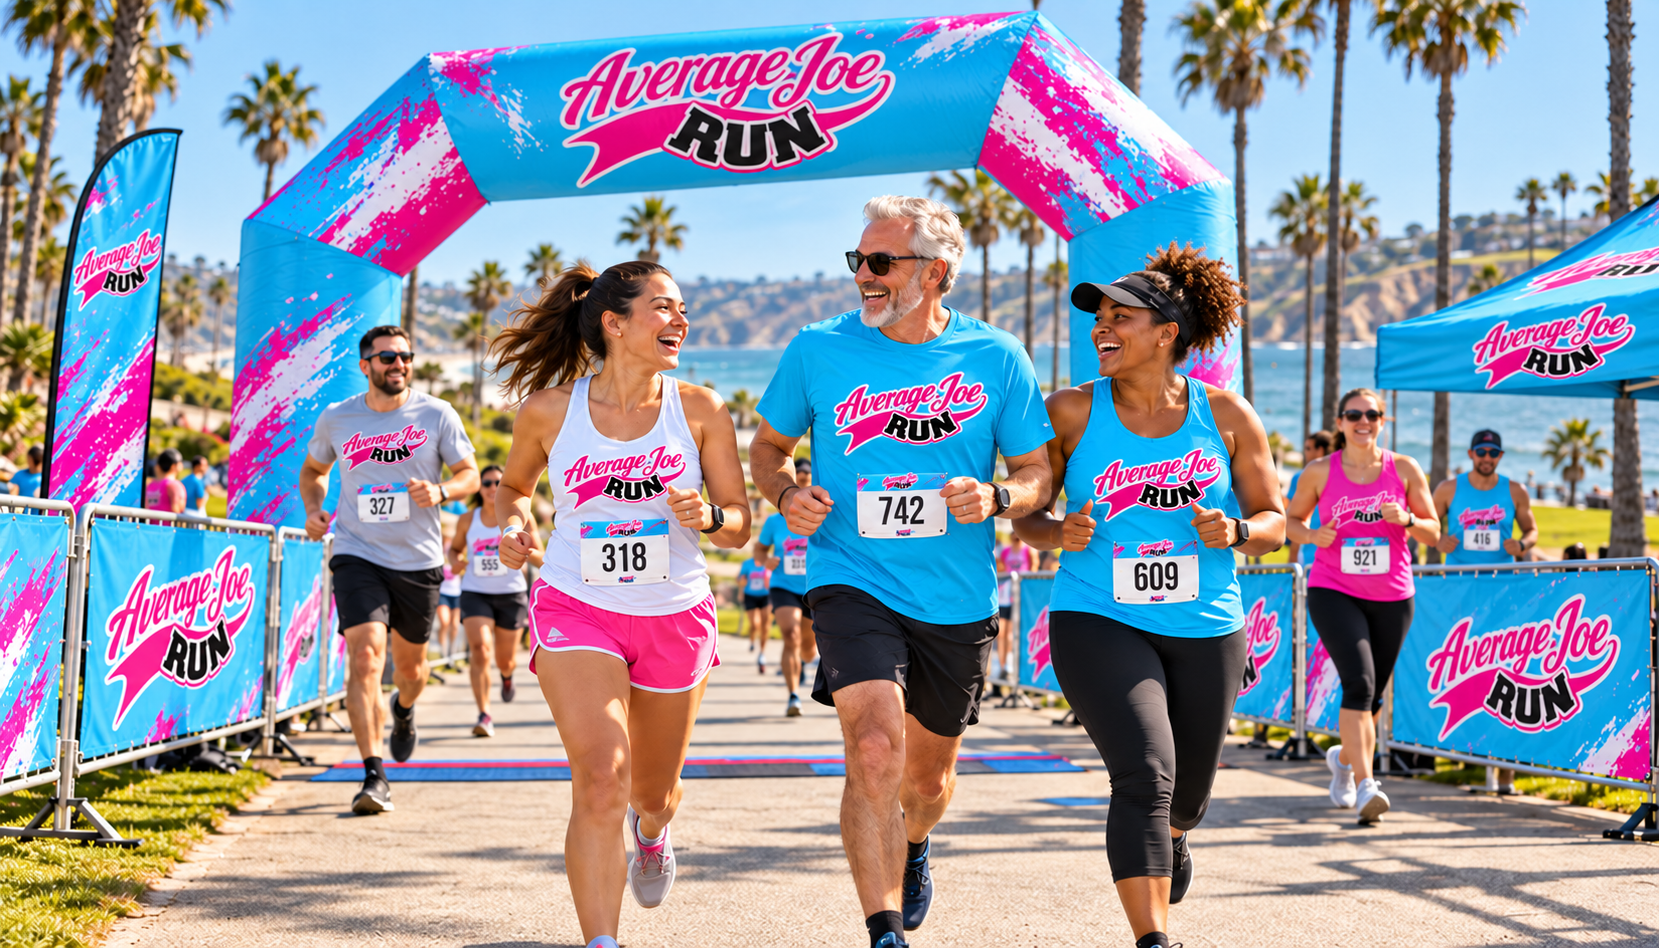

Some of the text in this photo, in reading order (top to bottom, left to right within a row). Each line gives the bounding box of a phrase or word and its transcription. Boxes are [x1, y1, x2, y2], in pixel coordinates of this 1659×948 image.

[563, 33, 882, 127] Average Joe
[667, 105, 828, 167] RUN
[73, 229, 161, 286] Average Joe
[102, 264, 146, 293] RUN
[1474, 304, 1627, 364] Average Joe
[1522, 344, 1599, 375] RUN
[835, 372, 983, 425] Average Joe
[342, 424, 426, 455] Average Joe
[883, 410, 957, 441] RUN
[369, 444, 412, 463] RUN
[563, 445, 683, 487] Average Joe
[603, 473, 665, 500] RUN
[1094, 448, 1217, 495] Average Joe
[369, 496, 395, 515] 327
[1137, 479, 1201, 508] RUN
[878, 495, 925, 525] 742
[1354, 509, 1384, 523] RUN
[1473, 532, 1491, 545] 416
[601, 542, 647, 573] 318
[1353, 549, 1377, 566] 921
[1134, 561, 1179, 592] 609
[108, 568, 212, 661] Average
[207, 548, 250, 622] Joe
[162, 619, 231, 682] RUN
[1428, 598, 1609, 690] Average Joe
[1485, 671, 1576, 725] RUN
